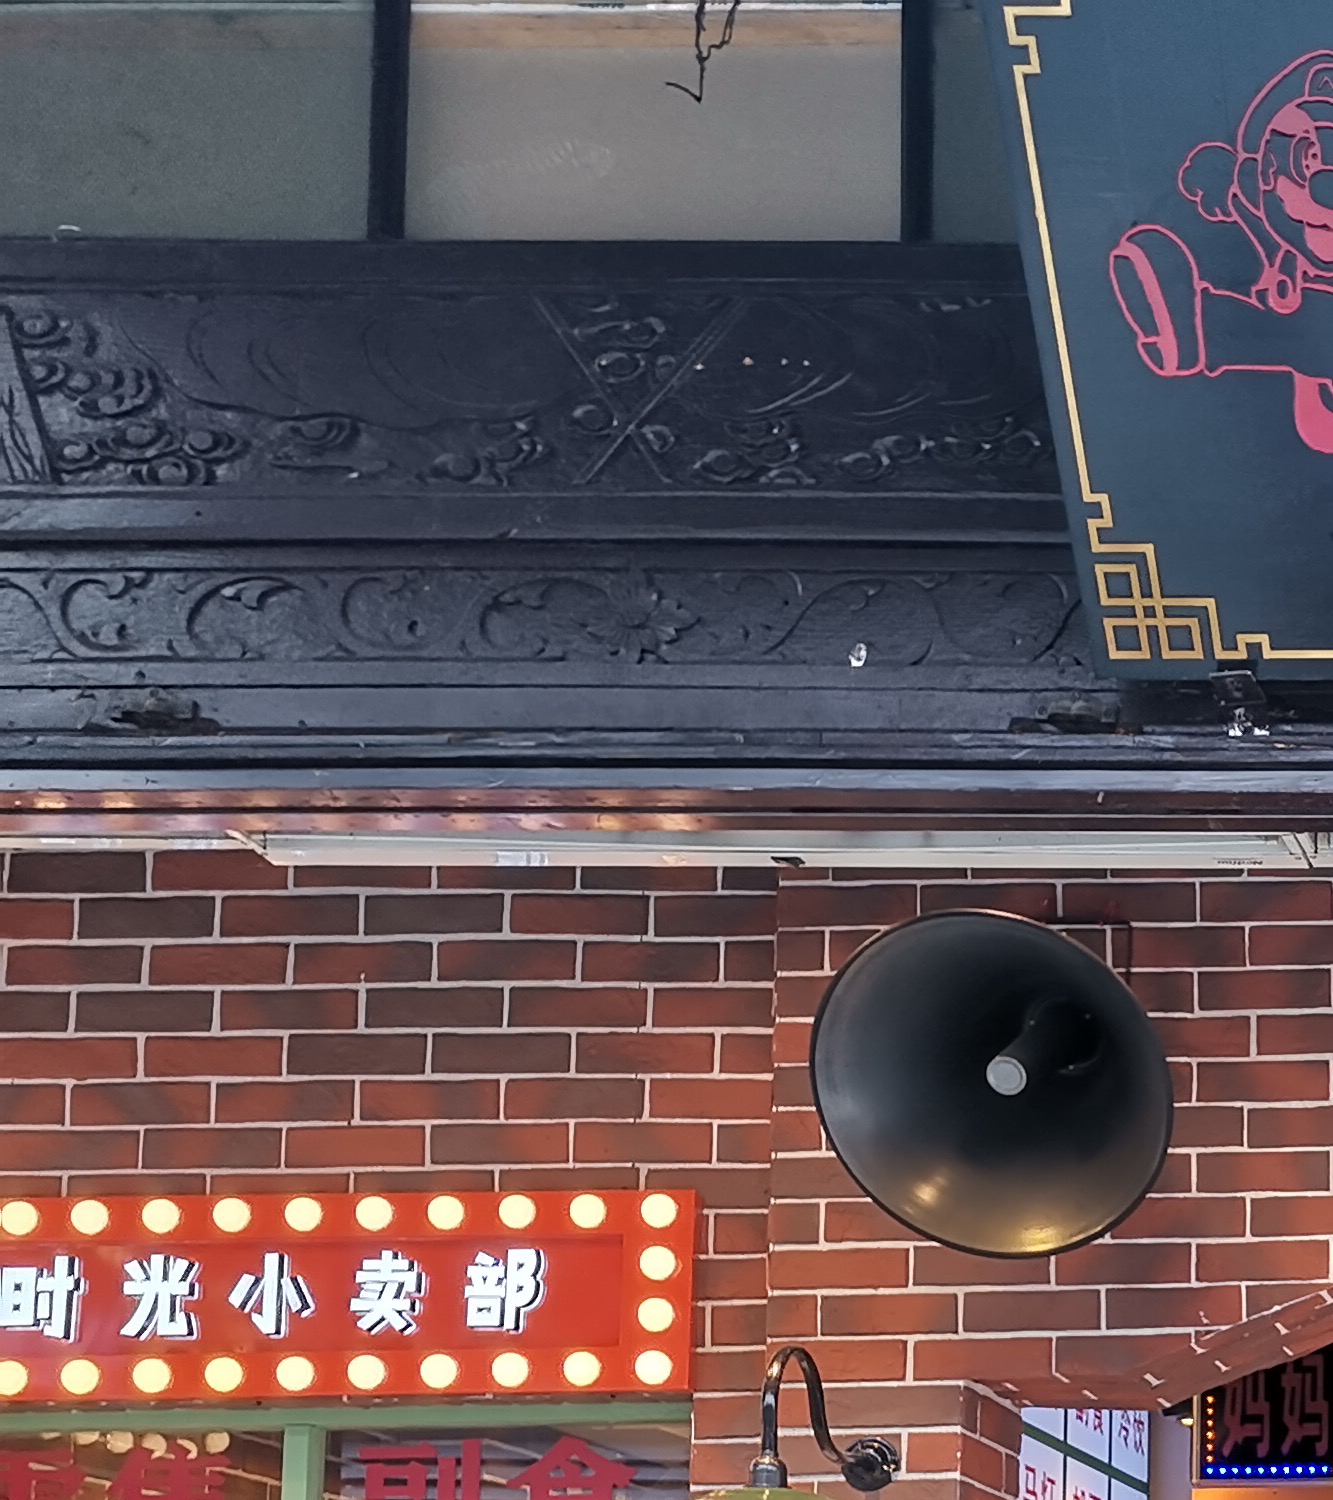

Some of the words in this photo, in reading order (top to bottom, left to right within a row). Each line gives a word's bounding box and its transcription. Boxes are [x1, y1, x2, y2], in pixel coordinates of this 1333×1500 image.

[0, 1248, 547, 1341] 时光小卖部
